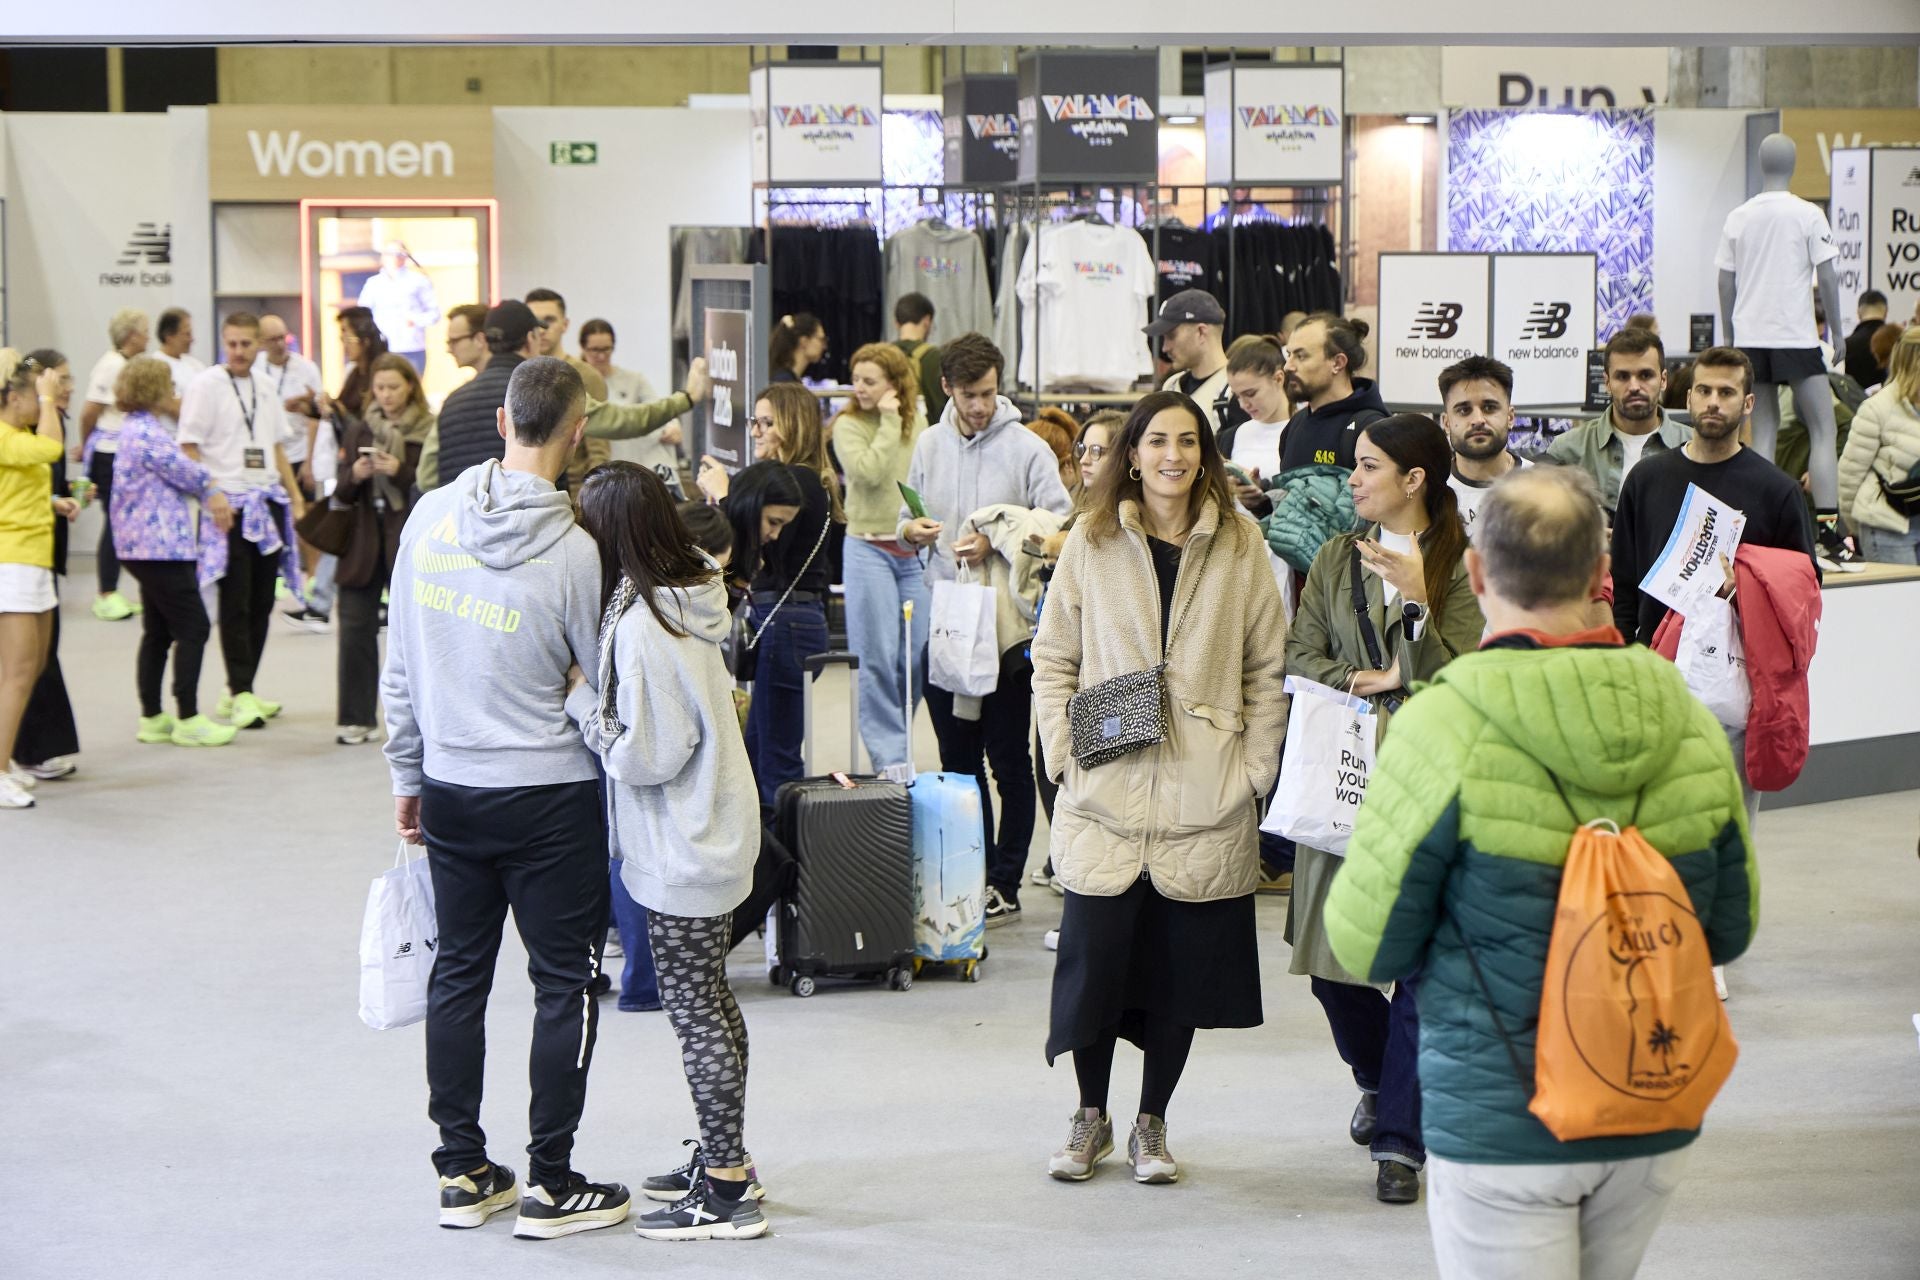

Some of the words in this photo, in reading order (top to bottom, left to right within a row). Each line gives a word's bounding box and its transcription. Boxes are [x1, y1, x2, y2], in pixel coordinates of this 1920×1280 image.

[247, 129, 454, 177] Women
[1838, 207, 1860, 232] Run
[1395, 347, 1419, 359] new
[1421, 345, 1472, 360] balance
[1508, 347, 1533, 360] new
[1533, 345, 1579, 360] balance
[1313, 449, 1336, 465] SAS
[1679, 506, 1718, 581] MARATHON
[457, 594, 472, 619] &
[472, 599, 521, 633] FIELD
[1341, 749, 1367, 773] Run
